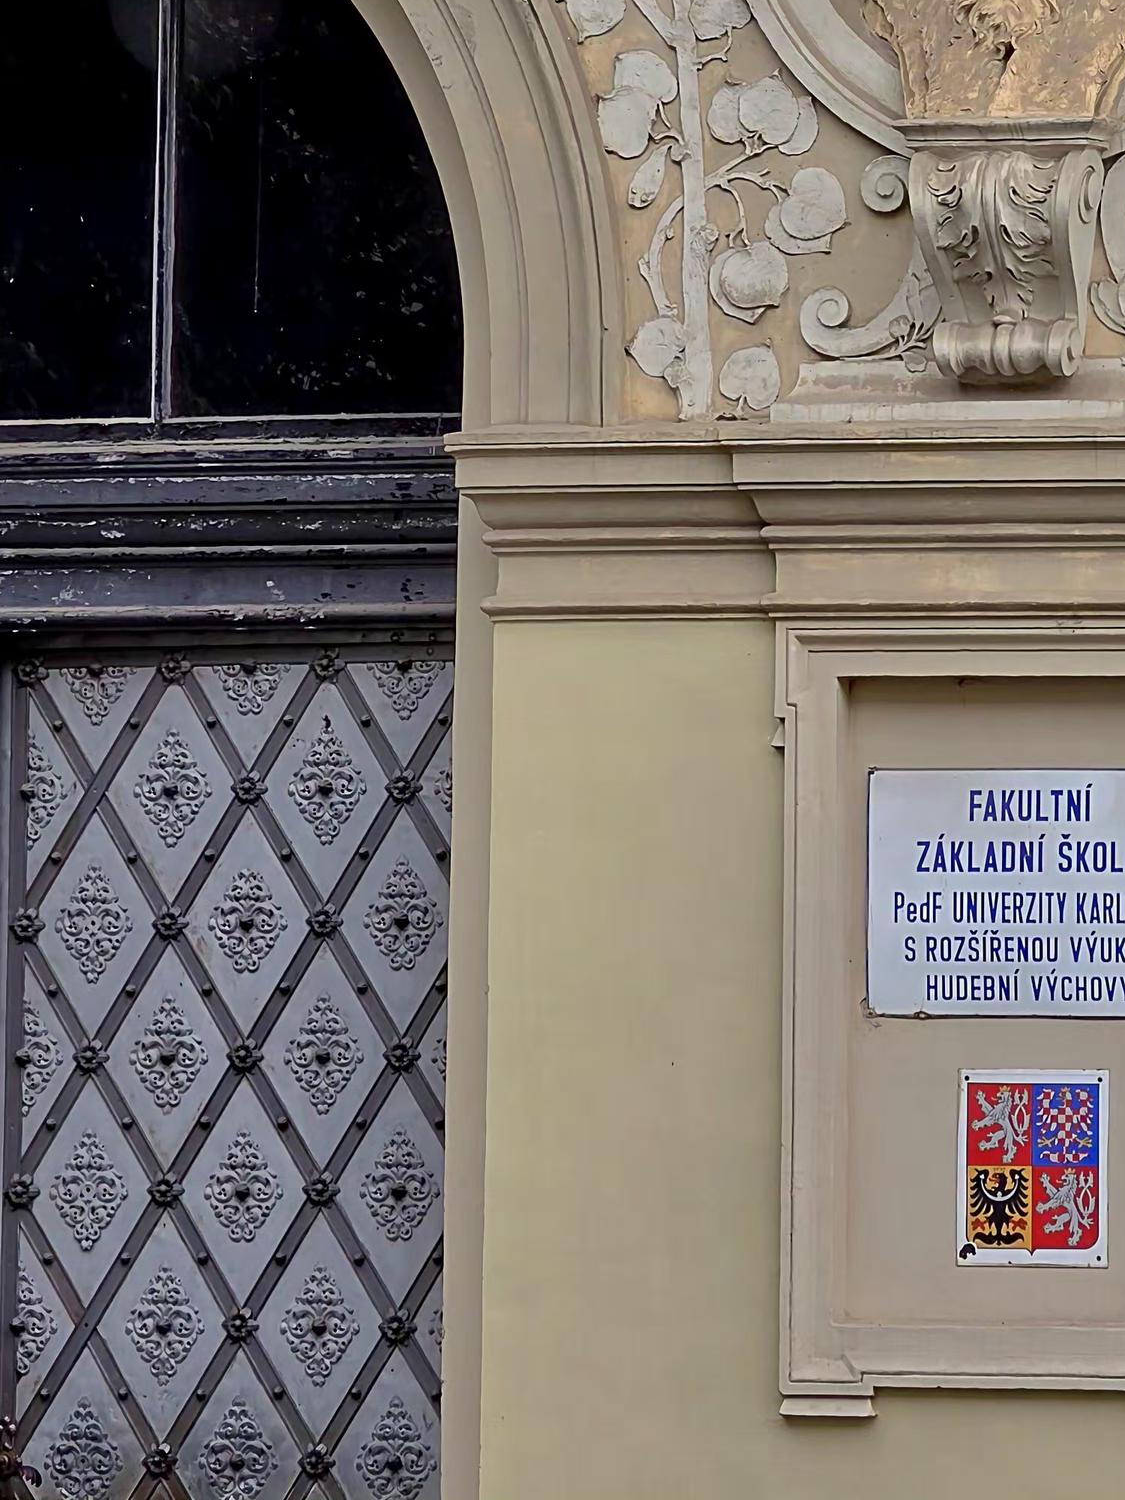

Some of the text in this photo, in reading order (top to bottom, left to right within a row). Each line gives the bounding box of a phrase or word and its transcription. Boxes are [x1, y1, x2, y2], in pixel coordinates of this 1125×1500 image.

[968, 783, 1093, 822] FAKULTNÍ
[916, 833, 1046, 873] ZÁKLADNÍ
[893, 891, 943, 924] PedF
[952, 891, 1067, 924] UNIVERZITY
[904, 936, 917, 963] S
[925, 929, 1059, 963] ROZŠÍŘENOU
[926, 968, 1021, 1002] HUDEBNÍ
